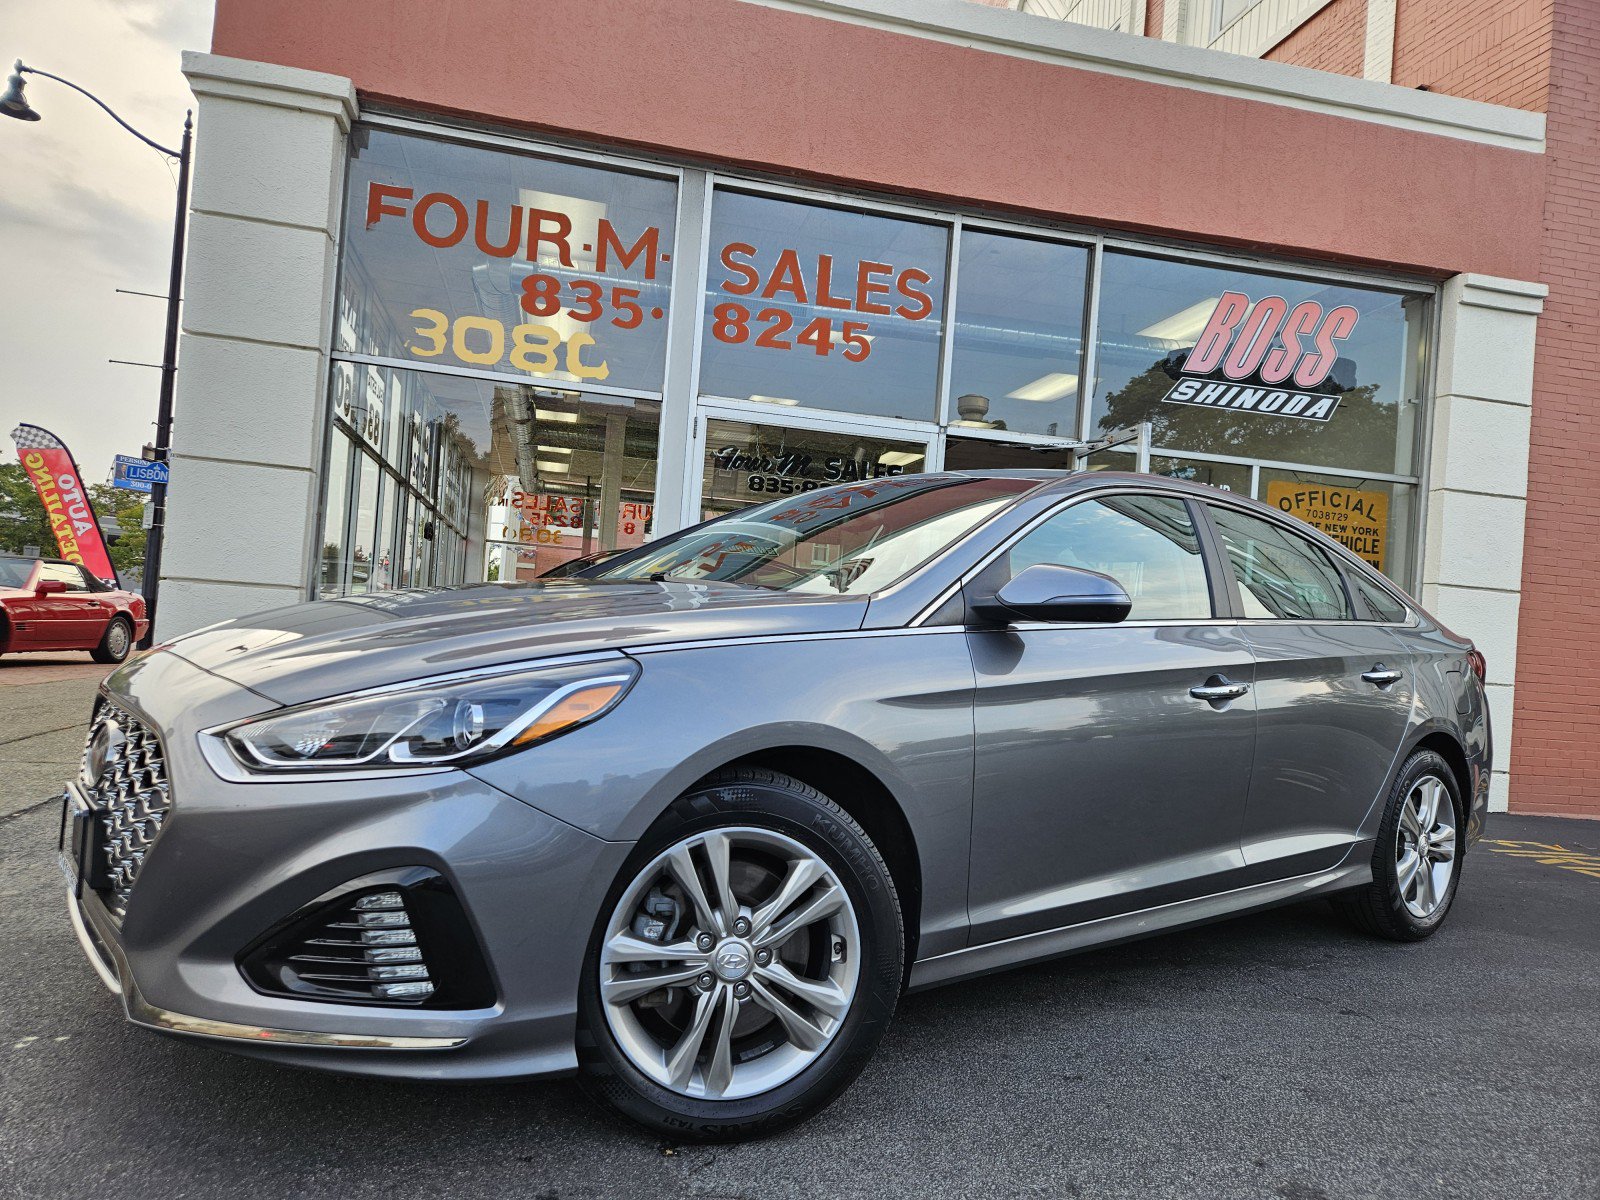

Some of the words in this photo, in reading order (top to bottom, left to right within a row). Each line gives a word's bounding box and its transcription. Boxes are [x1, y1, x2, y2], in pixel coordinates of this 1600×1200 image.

[720, 242, 934, 321] SALES
[712, 302, 872, 362] 8245
[1181, 290, 1359, 388] BOSS
[1170, 381, 1334, 418] SHINODA
[129, 467, 168, 481] LISBON
[823, 456, 904, 482] SALES
[1279, 490, 1378, 522] OFFICIAL
[1306, 508, 1349, 522] 7038729
[1325, 523, 1348, 533] NEW
[1351, 525, 1379, 537] YORK
[1329, 533, 1380, 554] HICLE
